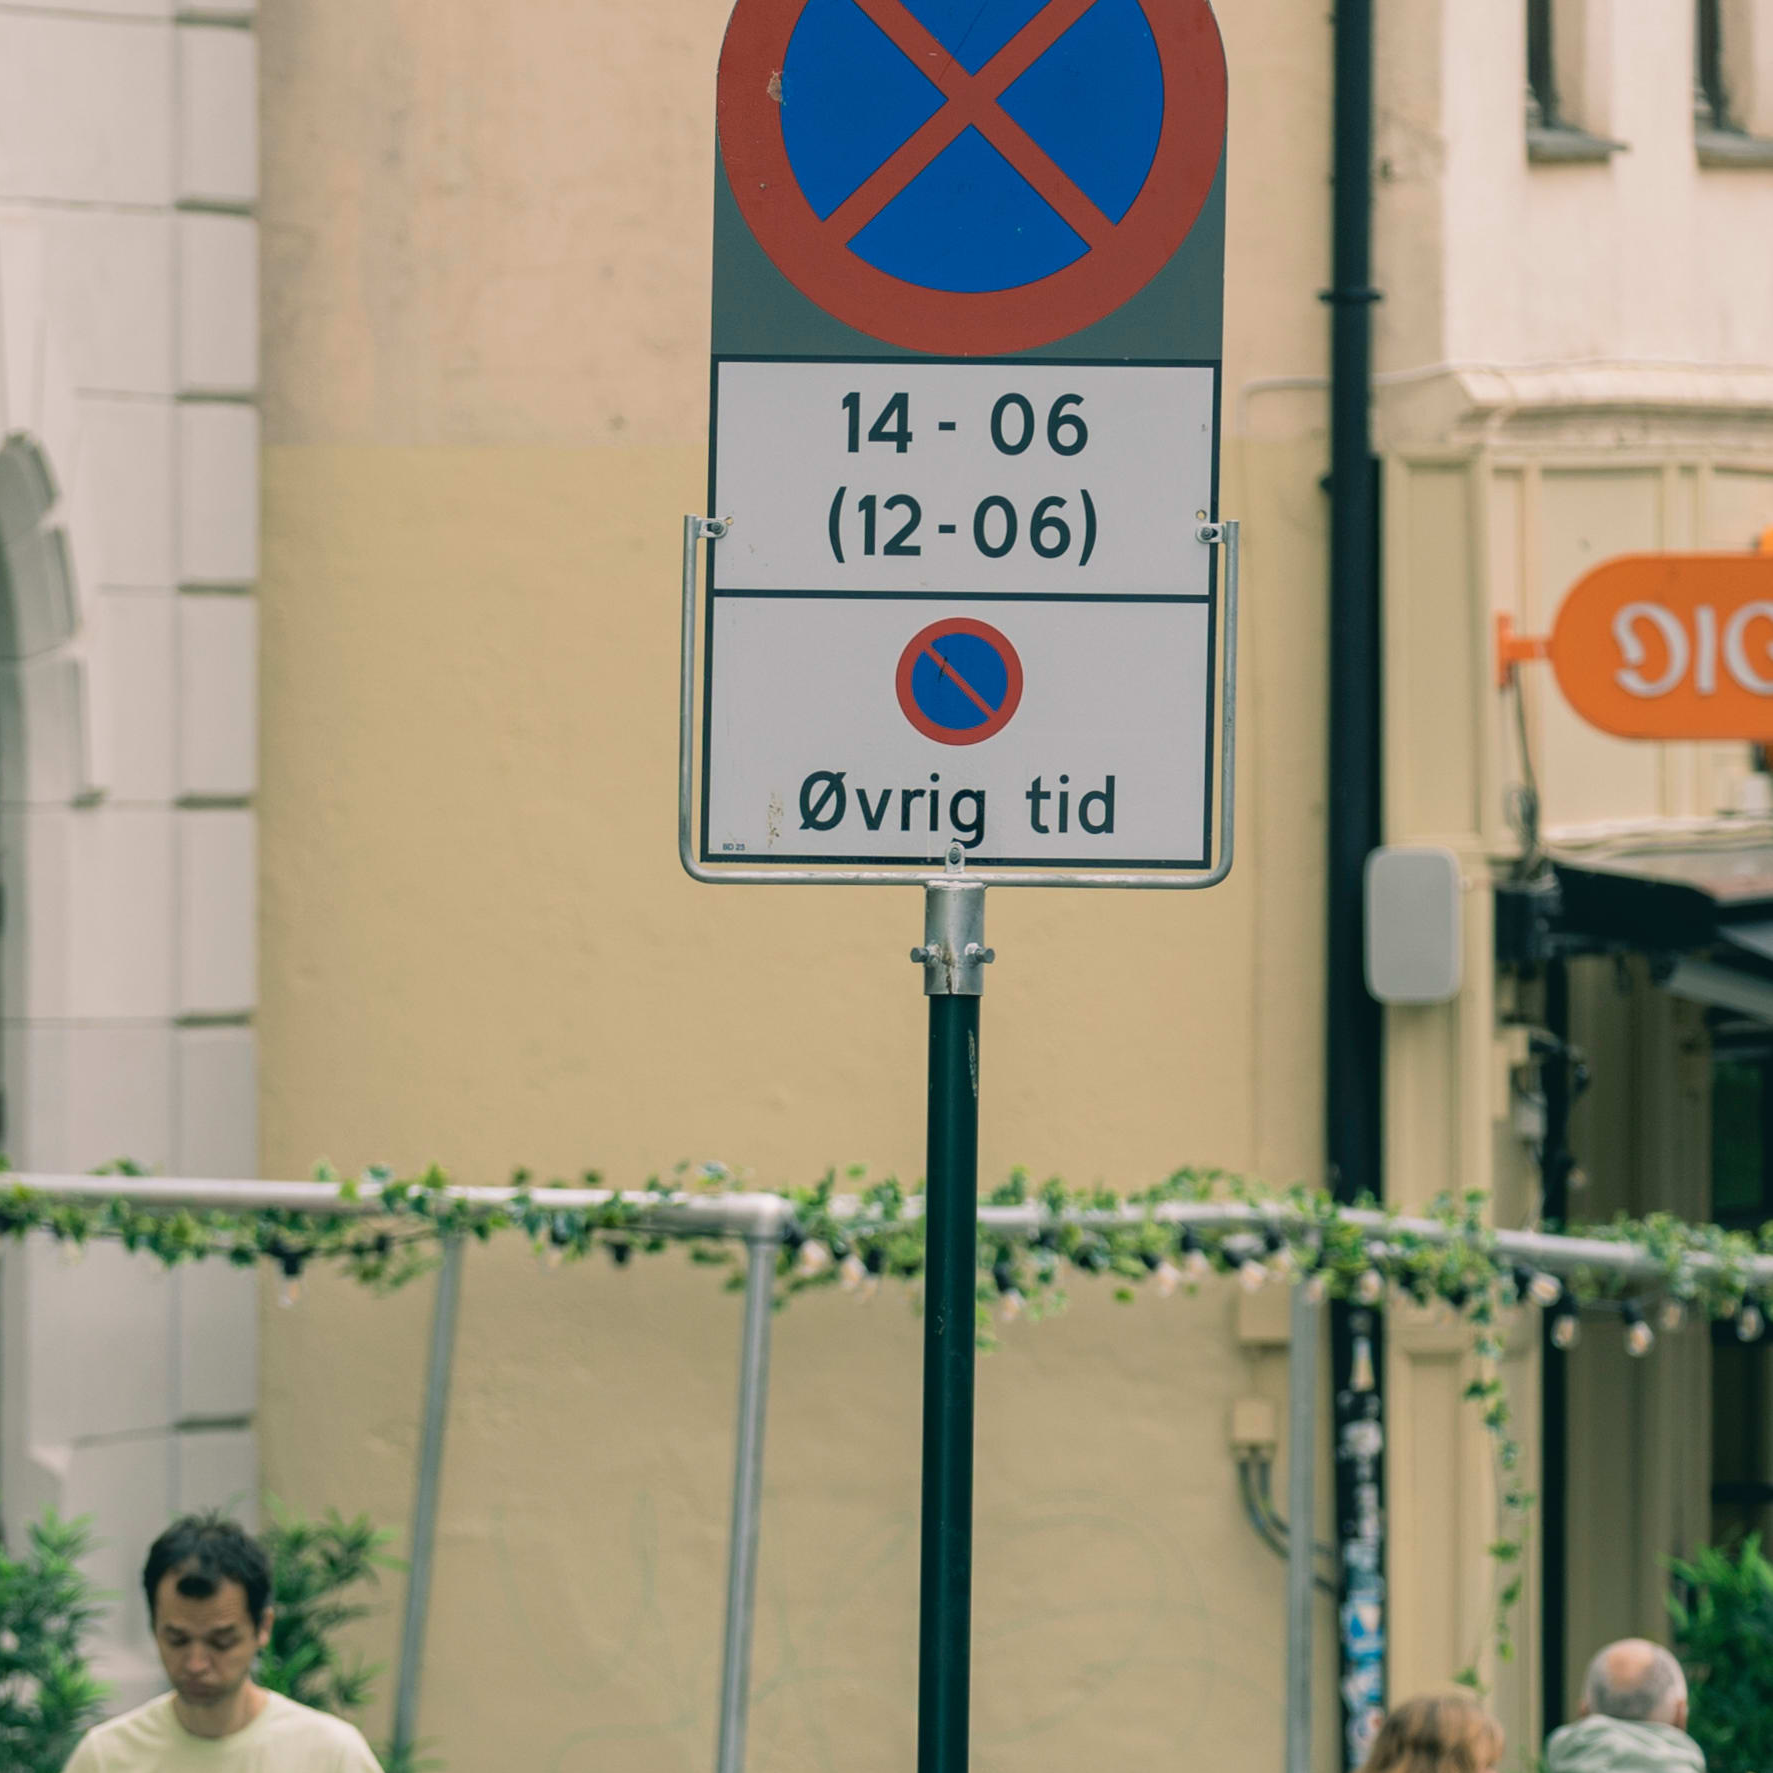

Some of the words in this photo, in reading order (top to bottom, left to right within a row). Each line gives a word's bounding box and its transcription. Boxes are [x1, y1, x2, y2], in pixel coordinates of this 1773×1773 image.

[841, 391, 913, 454] 14
[990, 392, 1089, 457] 06
[828, 486, 1097, 567] (12-06)
[798, 770, 987, 851] Øvrig
[1025, 774, 1116, 834] tid
